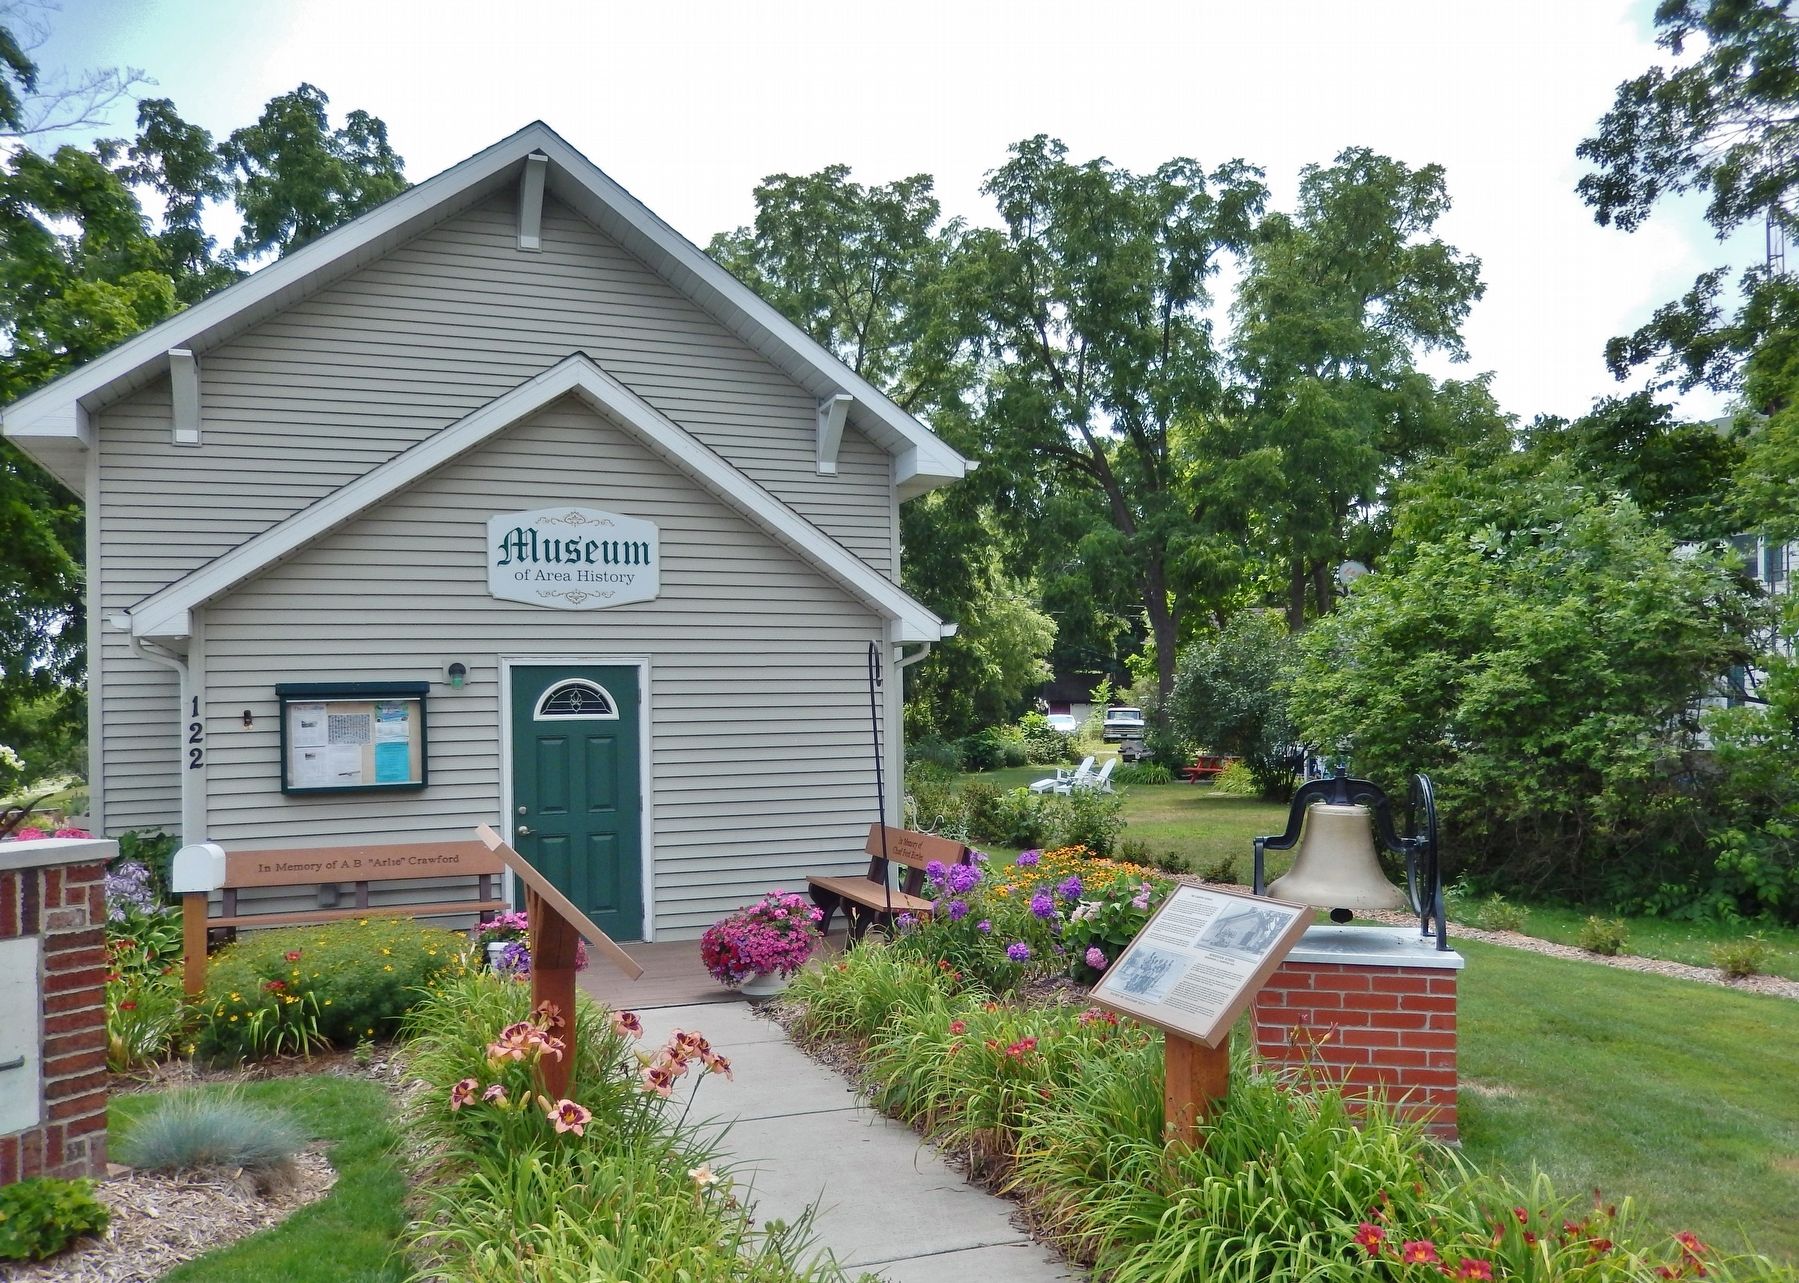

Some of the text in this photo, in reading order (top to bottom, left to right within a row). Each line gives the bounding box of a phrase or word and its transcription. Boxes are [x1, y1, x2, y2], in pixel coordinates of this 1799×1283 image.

[497, 526, 652, 567] Museum
[514, 569, 635, 585] of Area History
[189, 695, 204, 770] 122
[258, 863, 272, 873] In
[276, 862, 322, 872] Memory
[325, 860, 338, 869] of
[340, 859, 350, 869] A
[353, 859, 362, 868] B
[408, 855, 460, 865] Crawford
